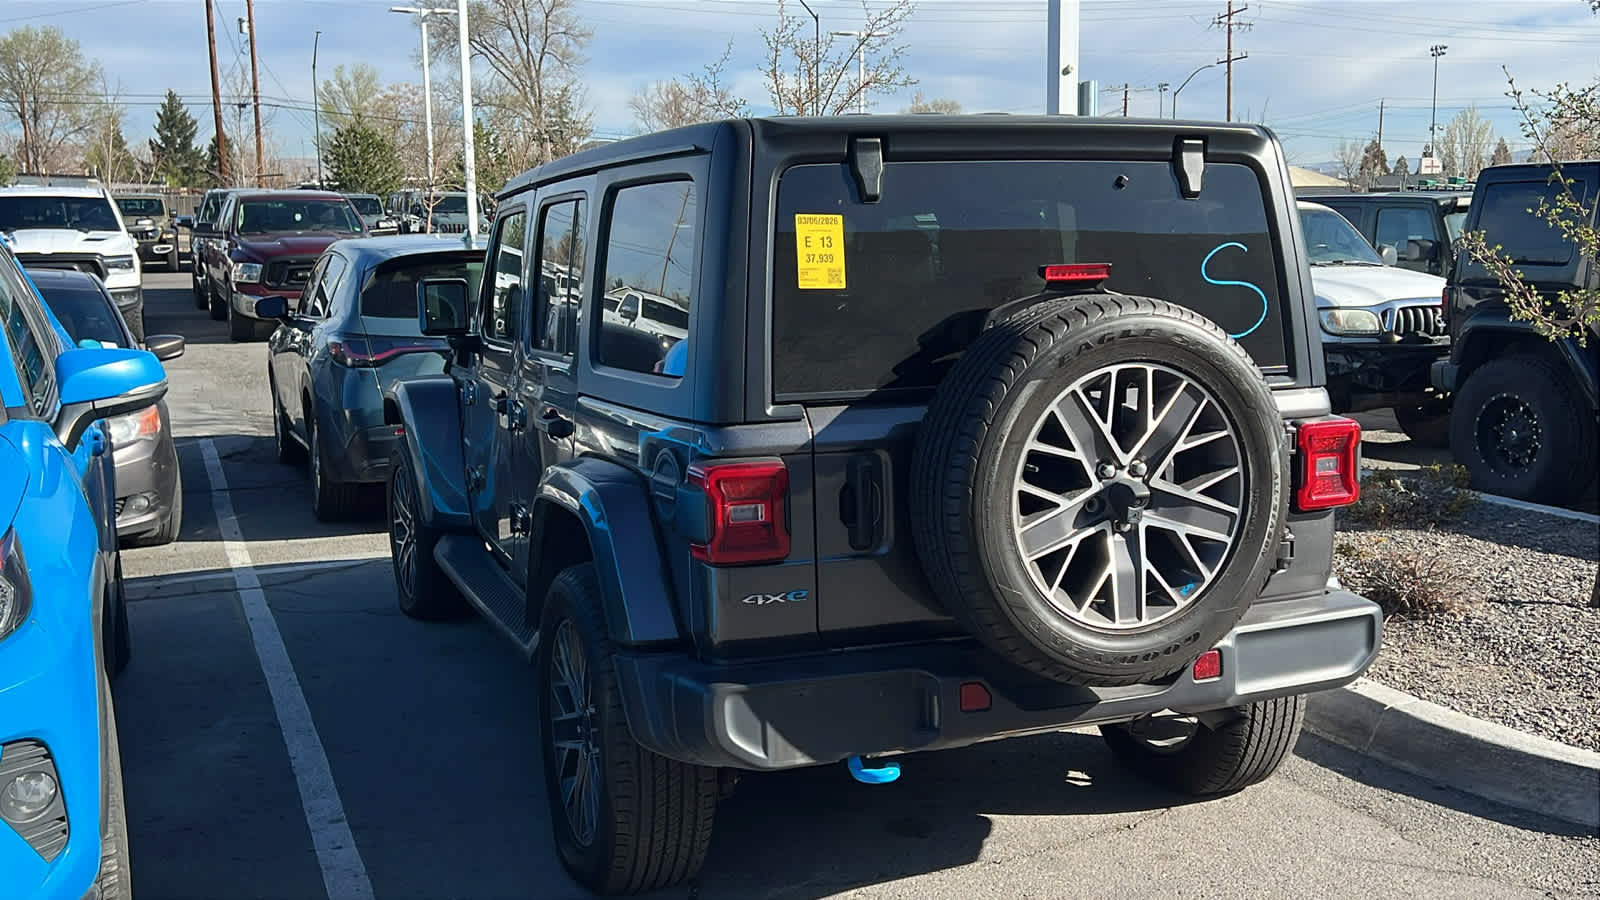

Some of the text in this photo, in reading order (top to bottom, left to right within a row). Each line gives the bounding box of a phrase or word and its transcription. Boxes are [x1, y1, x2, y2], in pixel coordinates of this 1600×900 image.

[805, 235, 833, 248] E 13
[806, 253, 834, 264] 37,939
[1201, 242, 1268, 339] S
[1058, 327, 1163, 368] EAGLE
